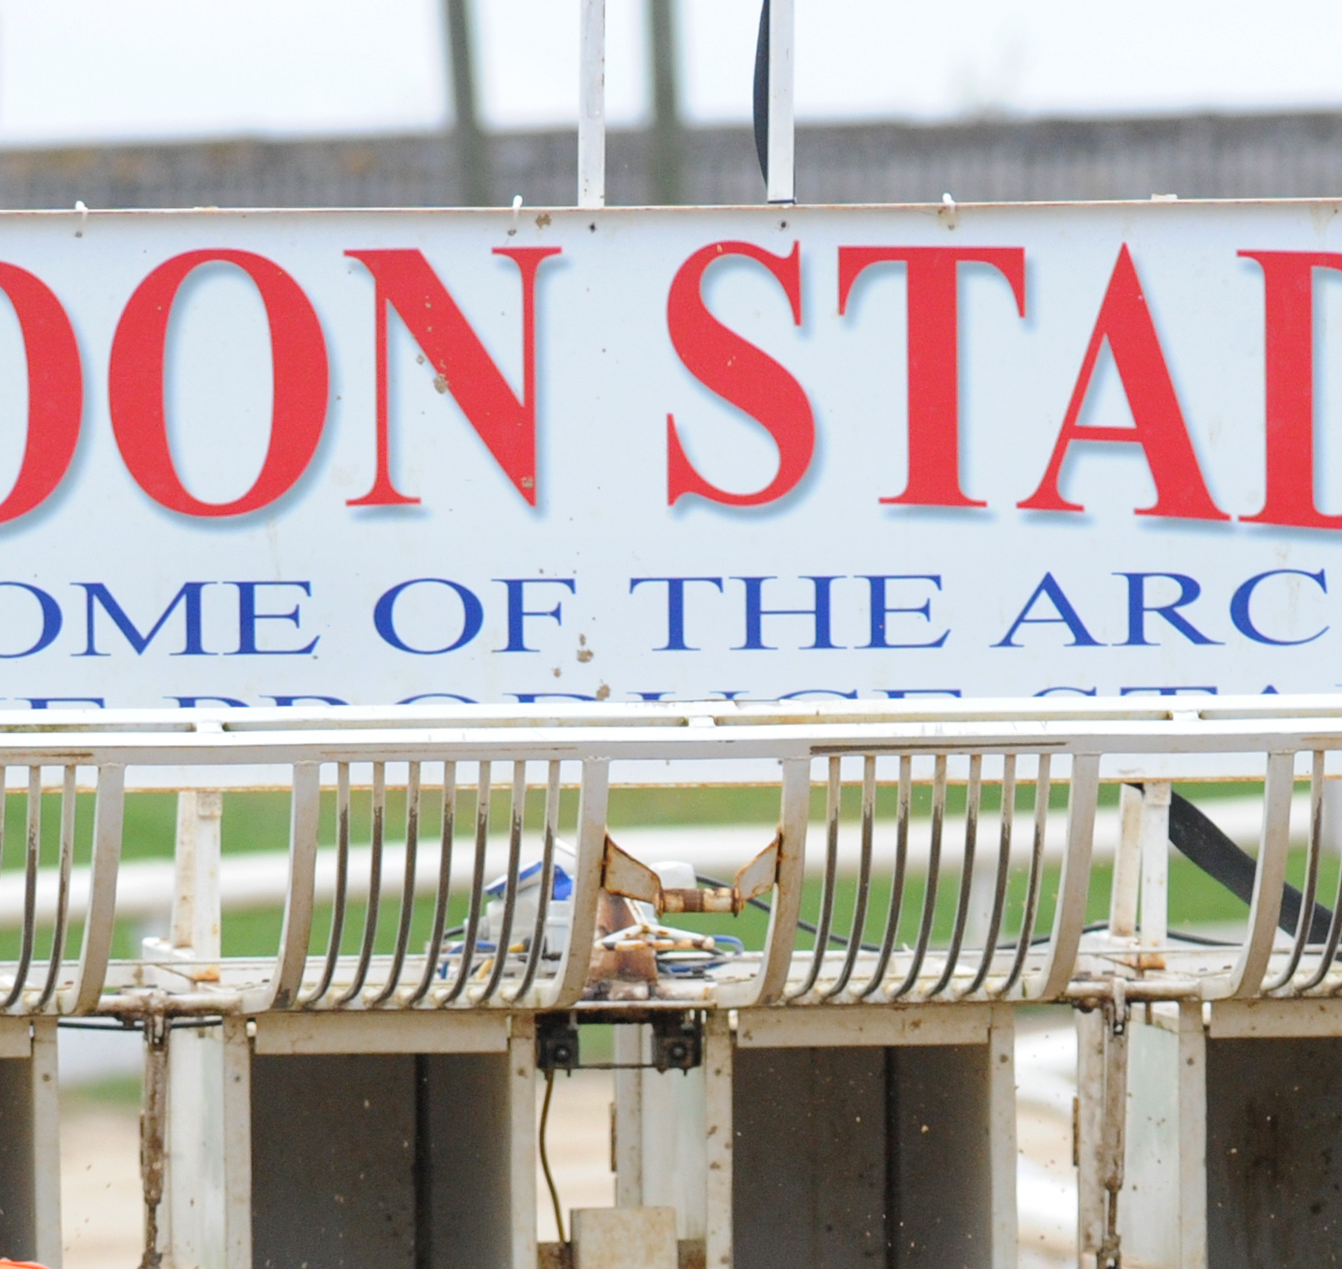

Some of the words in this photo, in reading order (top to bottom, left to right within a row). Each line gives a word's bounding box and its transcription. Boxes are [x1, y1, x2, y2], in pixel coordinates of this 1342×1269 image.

[372, 577, 577, 656] OF
[629, 574, 952, 652] THE
[990, 568, 1330, 651] ARC
